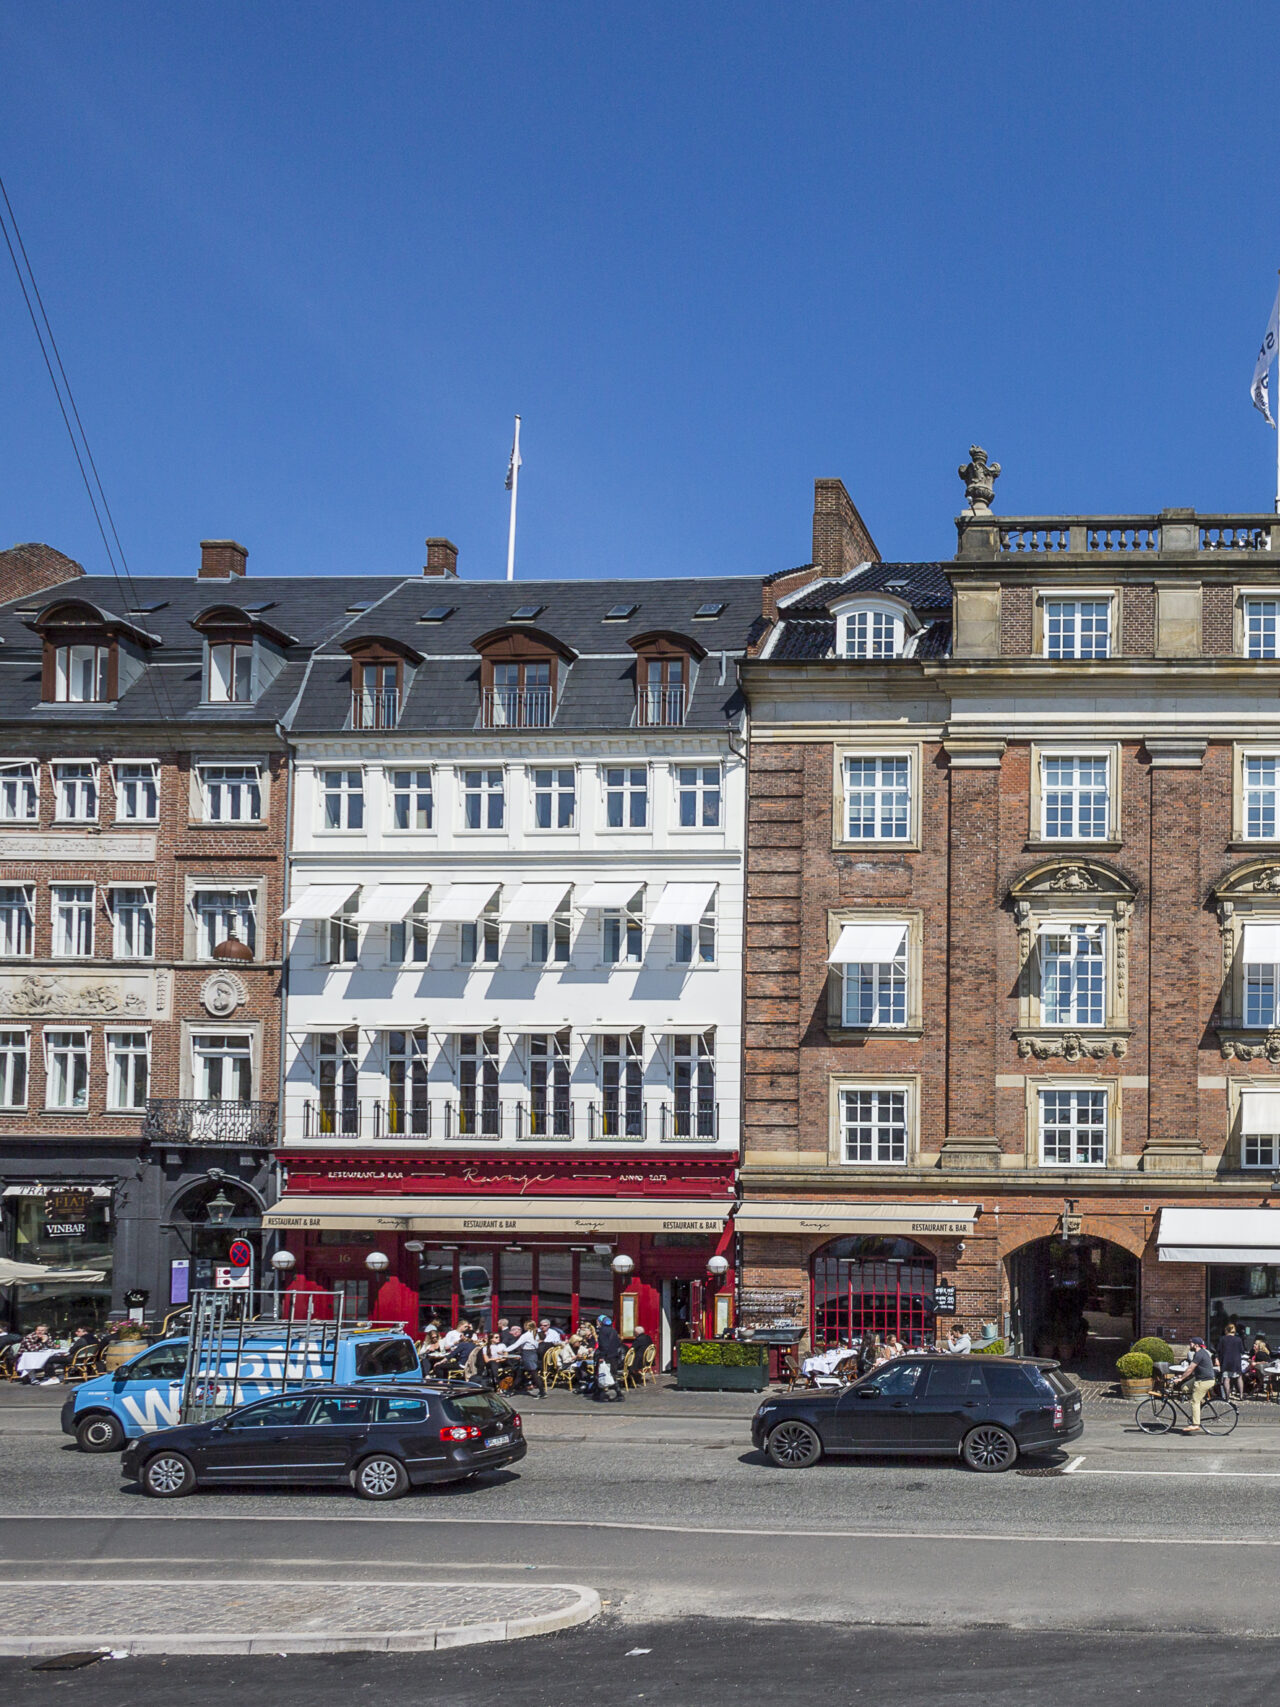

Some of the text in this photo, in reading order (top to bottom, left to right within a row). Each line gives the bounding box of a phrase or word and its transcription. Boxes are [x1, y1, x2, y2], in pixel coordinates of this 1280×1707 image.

[462, 1167, 555, 1195] Ravage
[55, 1196, 88, 1207] FIAT
[267, 1218, 321, 1226] RESTAURANT & BAR
[463, 1220, 517, 1229] RESTAURANT & BAR
[663, 1221, 717, 1230] RESTAURANT & BAR
[46, 1223, 86, 1234] VINBAR
[912, 1223, 967, 1232] RESTAURANT & BAR
[339, 1253, 351, 1263] 16
